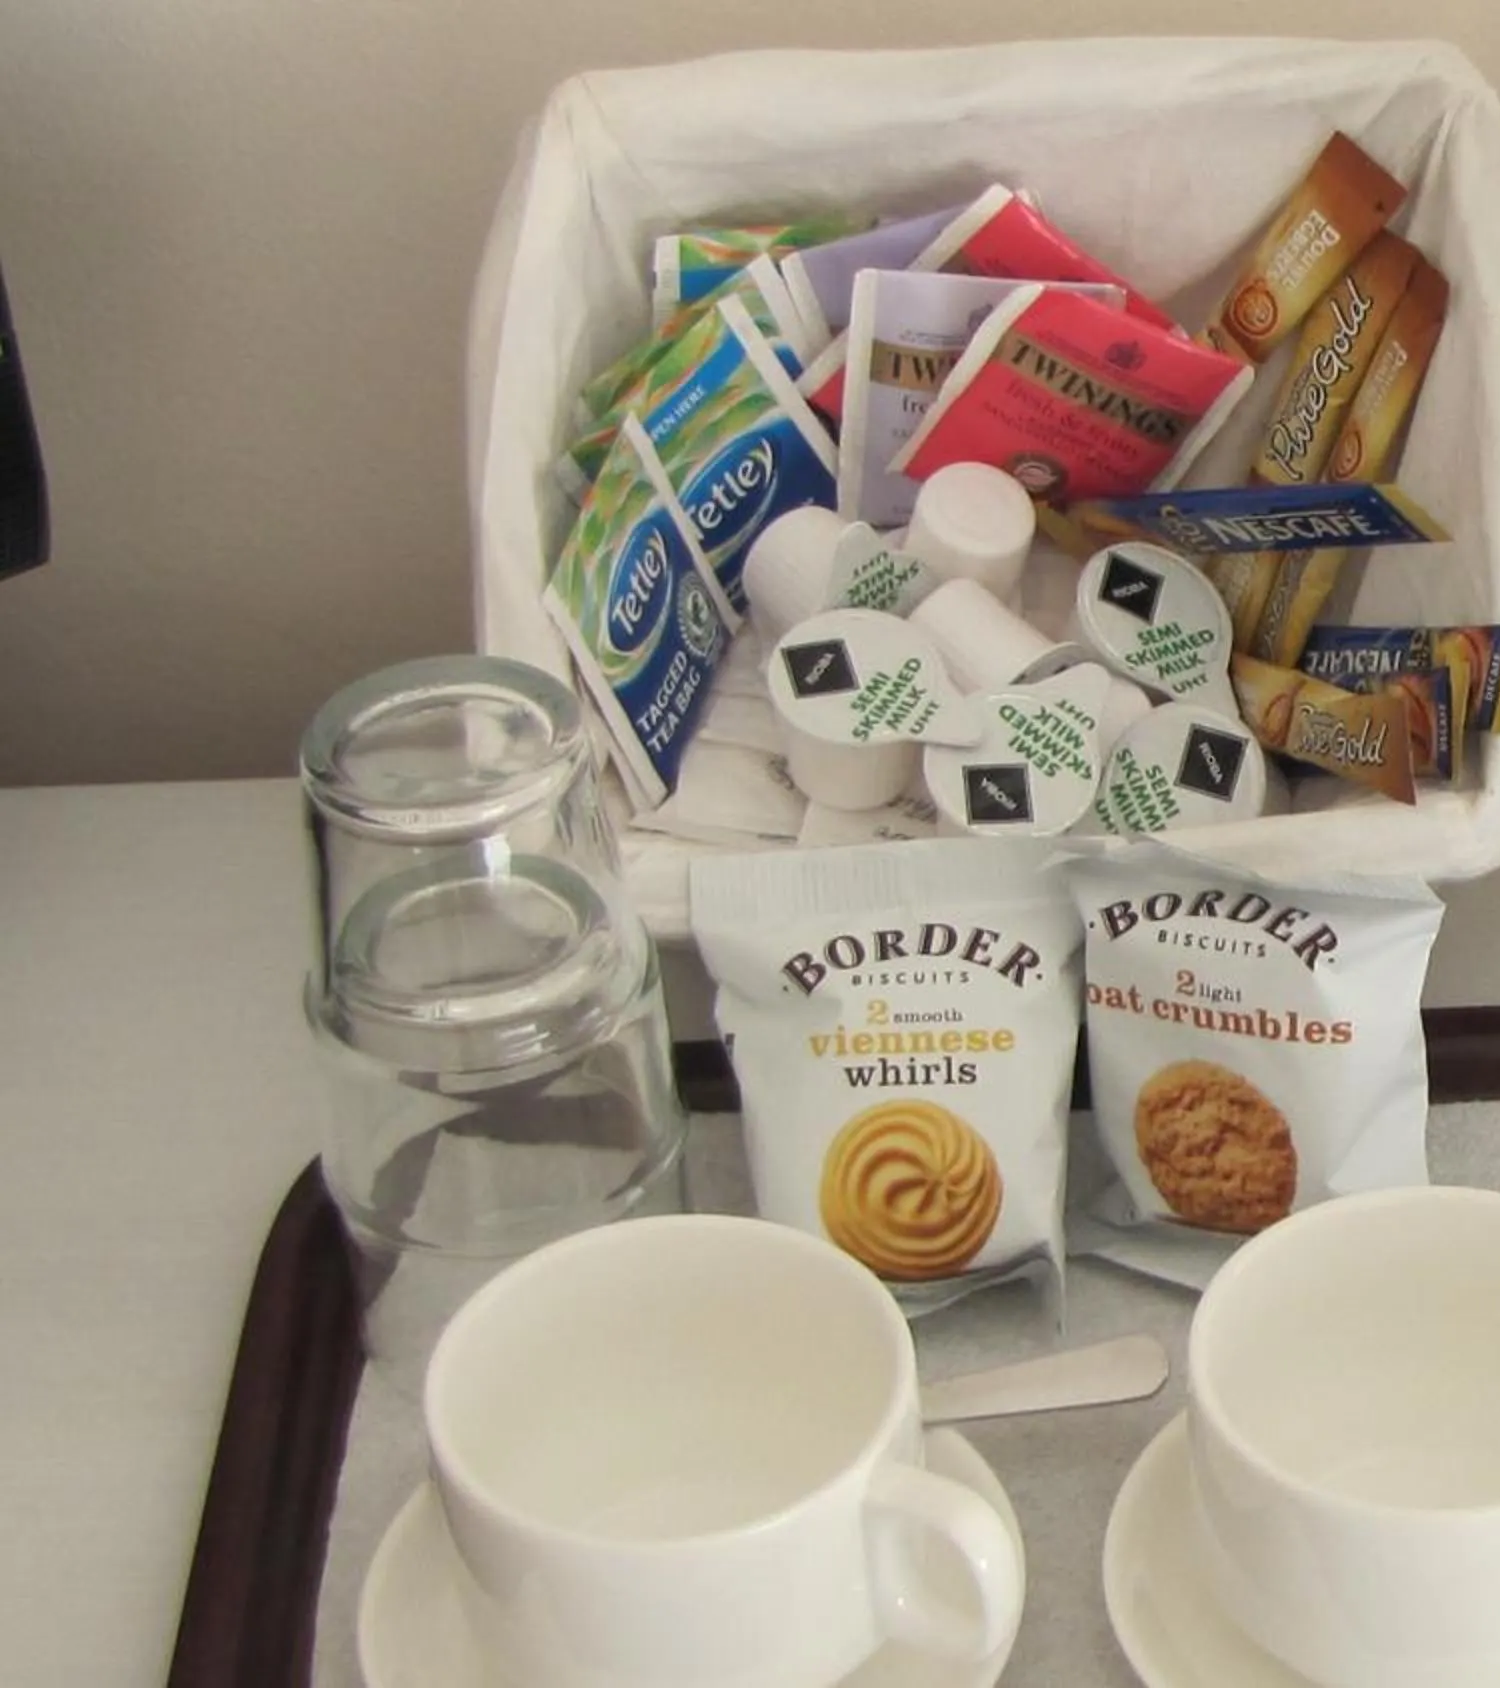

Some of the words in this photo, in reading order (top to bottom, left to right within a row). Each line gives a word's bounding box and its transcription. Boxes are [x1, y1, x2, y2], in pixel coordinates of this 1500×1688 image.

[1011, 338, 1179, 440] TWININGS
[687, 437, 774, 541] Tetley
[612, 528, 668, 637] Tetley
[1124, 628, 1215, 672] SKIMMED
[1137, 621, 1183, 648] SEMI
[1156, 650, 1206, 681] MILK
[1172, 673, 1209, 697] UHT
[637, 649, 689, 733] TAGGED
[647, 709, 682, 754] TEA
[673, 664, 702, 718] BAG
[850, 670, 893, 711] SEMI
[852, 657, 922, 743] SKIMMED
[885, 684, 928, 732] MILK
[909, 700, 940, 737] UHT
[1031, 705, 1085, 750] MILK
[1054, 698, 1096, 731] UHT
[998, 704, 1093, 781] SKIMMED
[1008, 735, 1062, 778] SEMI
[1109, 782, 1146, 833] MILK
[1115, 747, 1167, 833] SKIMM
[1145, 763, 1180, 819] SEMI
[1100, 888, 1339, 972] BORDER
[1157, 929, 1267, 958] BISCUITS
[782, 922, 1042, 998] BORDER
[851, 970, 971, 986] BISCUITS
[1176, 969, 1196, 997] 2
[1199, 984, 1242, 1004] light
[866, 998, 889, 1025] 2
[893, 1009, 964, 1024] smooth
[1086, 981, 1144, 1014] oat
[1152, 997, 1354, 1045] crumbles
[808, 1025, 1016, 1058] viennese
[844, 1056, 978, 1088] whirls
